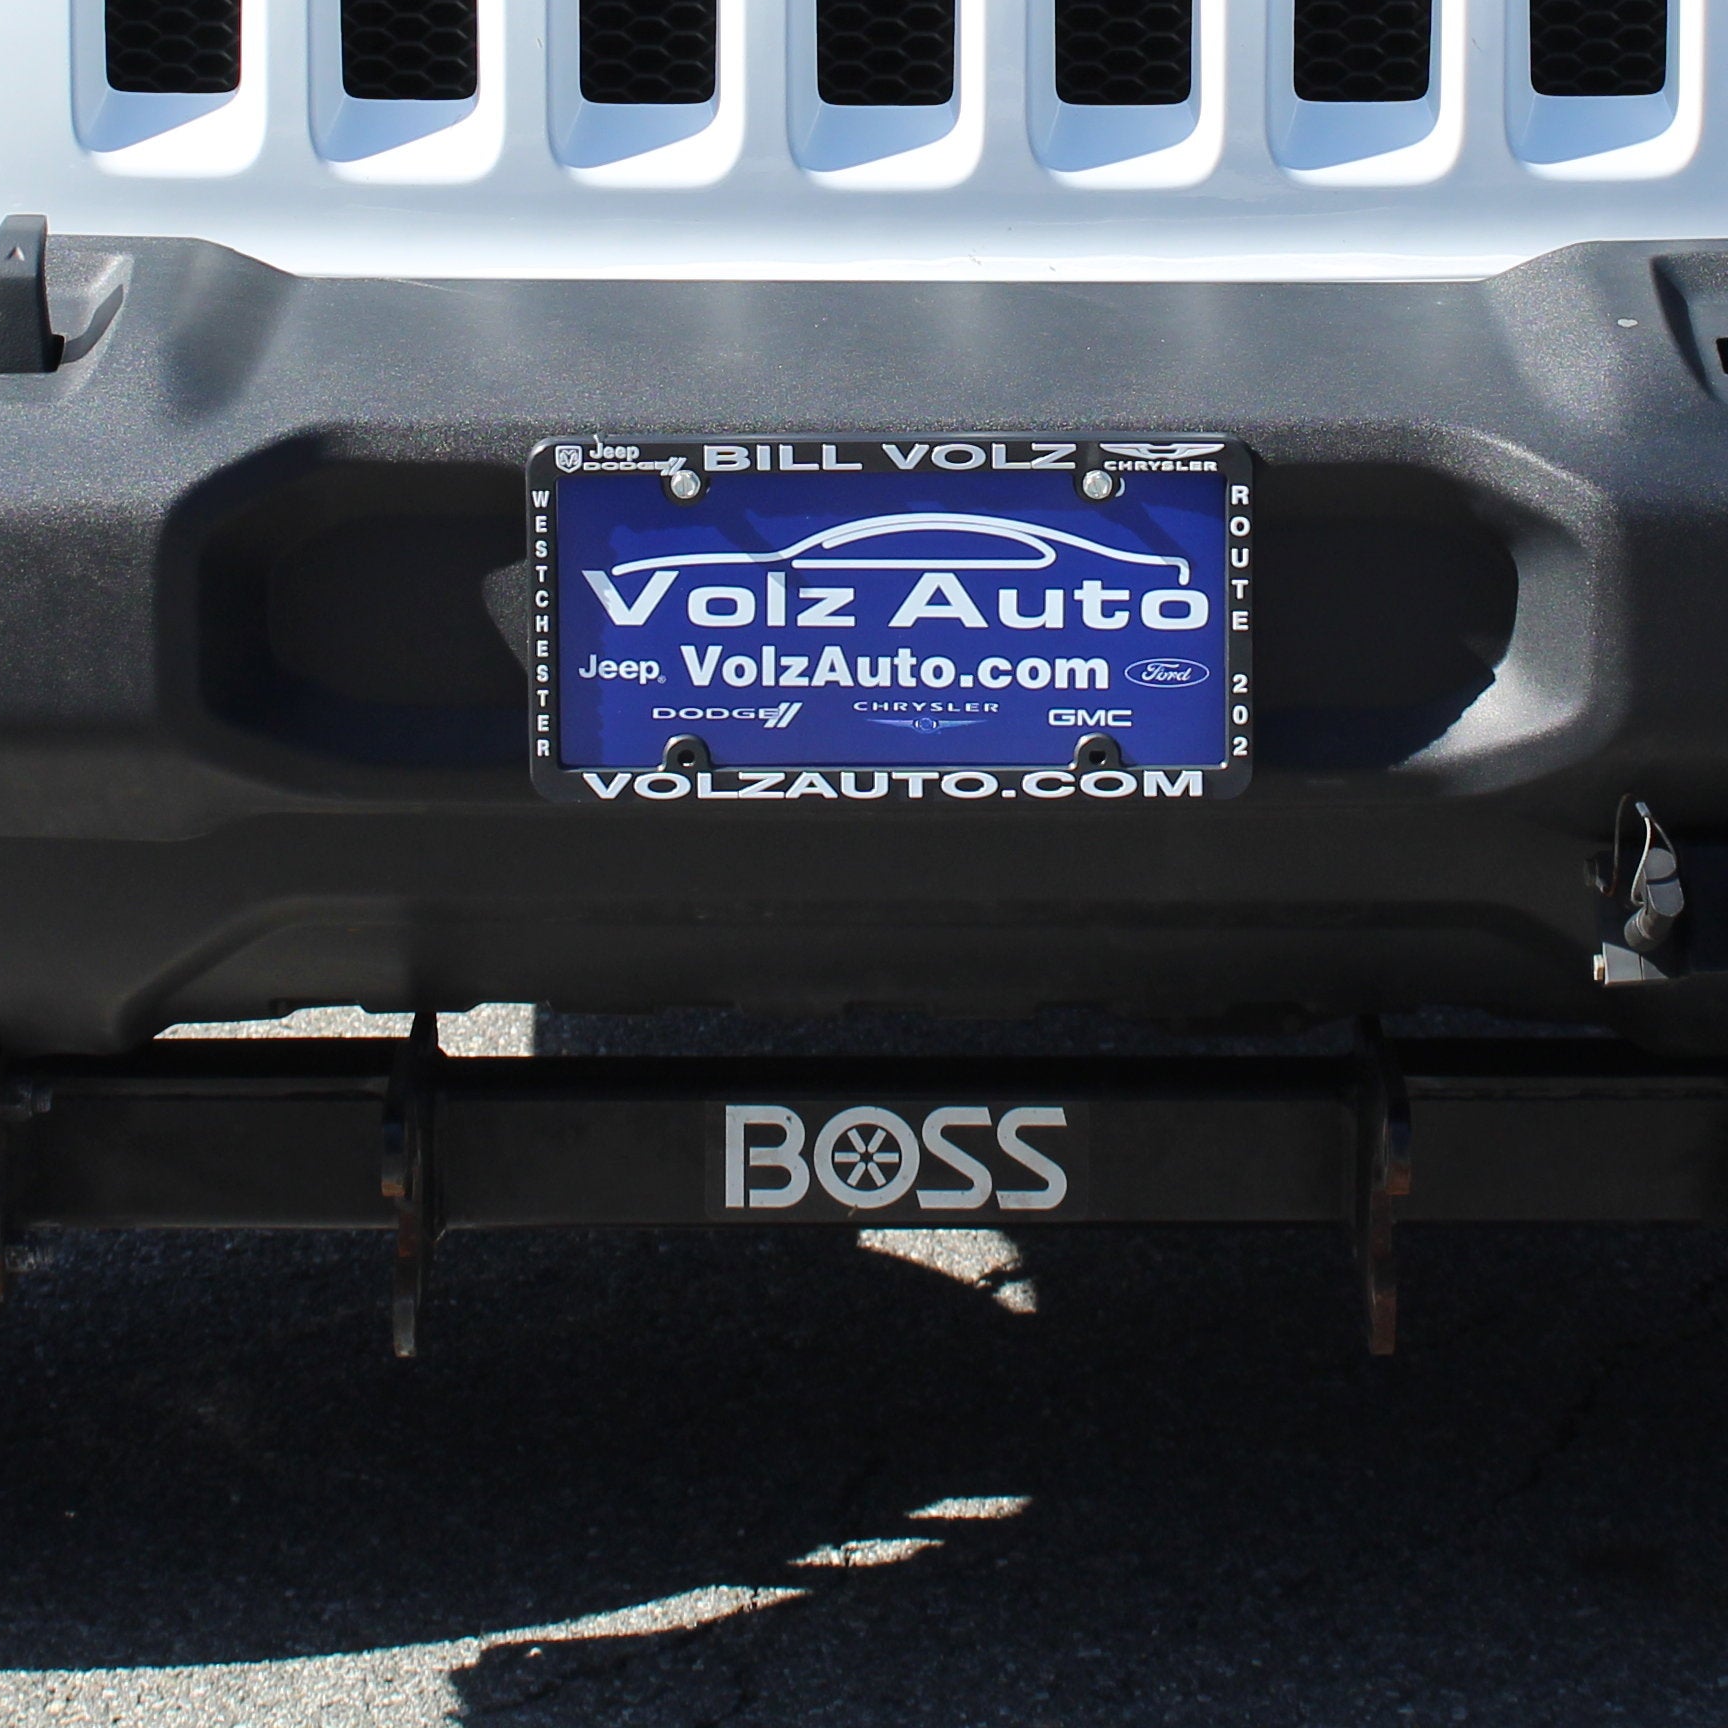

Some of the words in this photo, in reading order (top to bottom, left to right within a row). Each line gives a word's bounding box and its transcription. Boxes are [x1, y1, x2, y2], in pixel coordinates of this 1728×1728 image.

[589, 443, 640, 461] Jeep
[704, 444, 863, 472] BILL
[882, 443, 1077, 470] VOLZ
[1104, 460, 1218, 472] CHRYSLER
[1229, 484, 1252, 631] ROUTE
[581, 570, 856, 628] Volz
[887, 572, 1210, 630] Auto
[531, 490, 551, 757] WESTCHESTER
[680, 645, 1110, 690] VolzAuto.com
[1141, 663, 1193, 683] Ford
[652, 706, 780, 720] DODGE
[853, 701, 1000, 714] CHRYSLER
[1048, 708, 1133, 727] GMC
[1231, 673, 1250, 757] 202
[582, 770, 1204, 800] VOLZAUTO.COM
[725, 1104, 1068, 1210] BOSS
